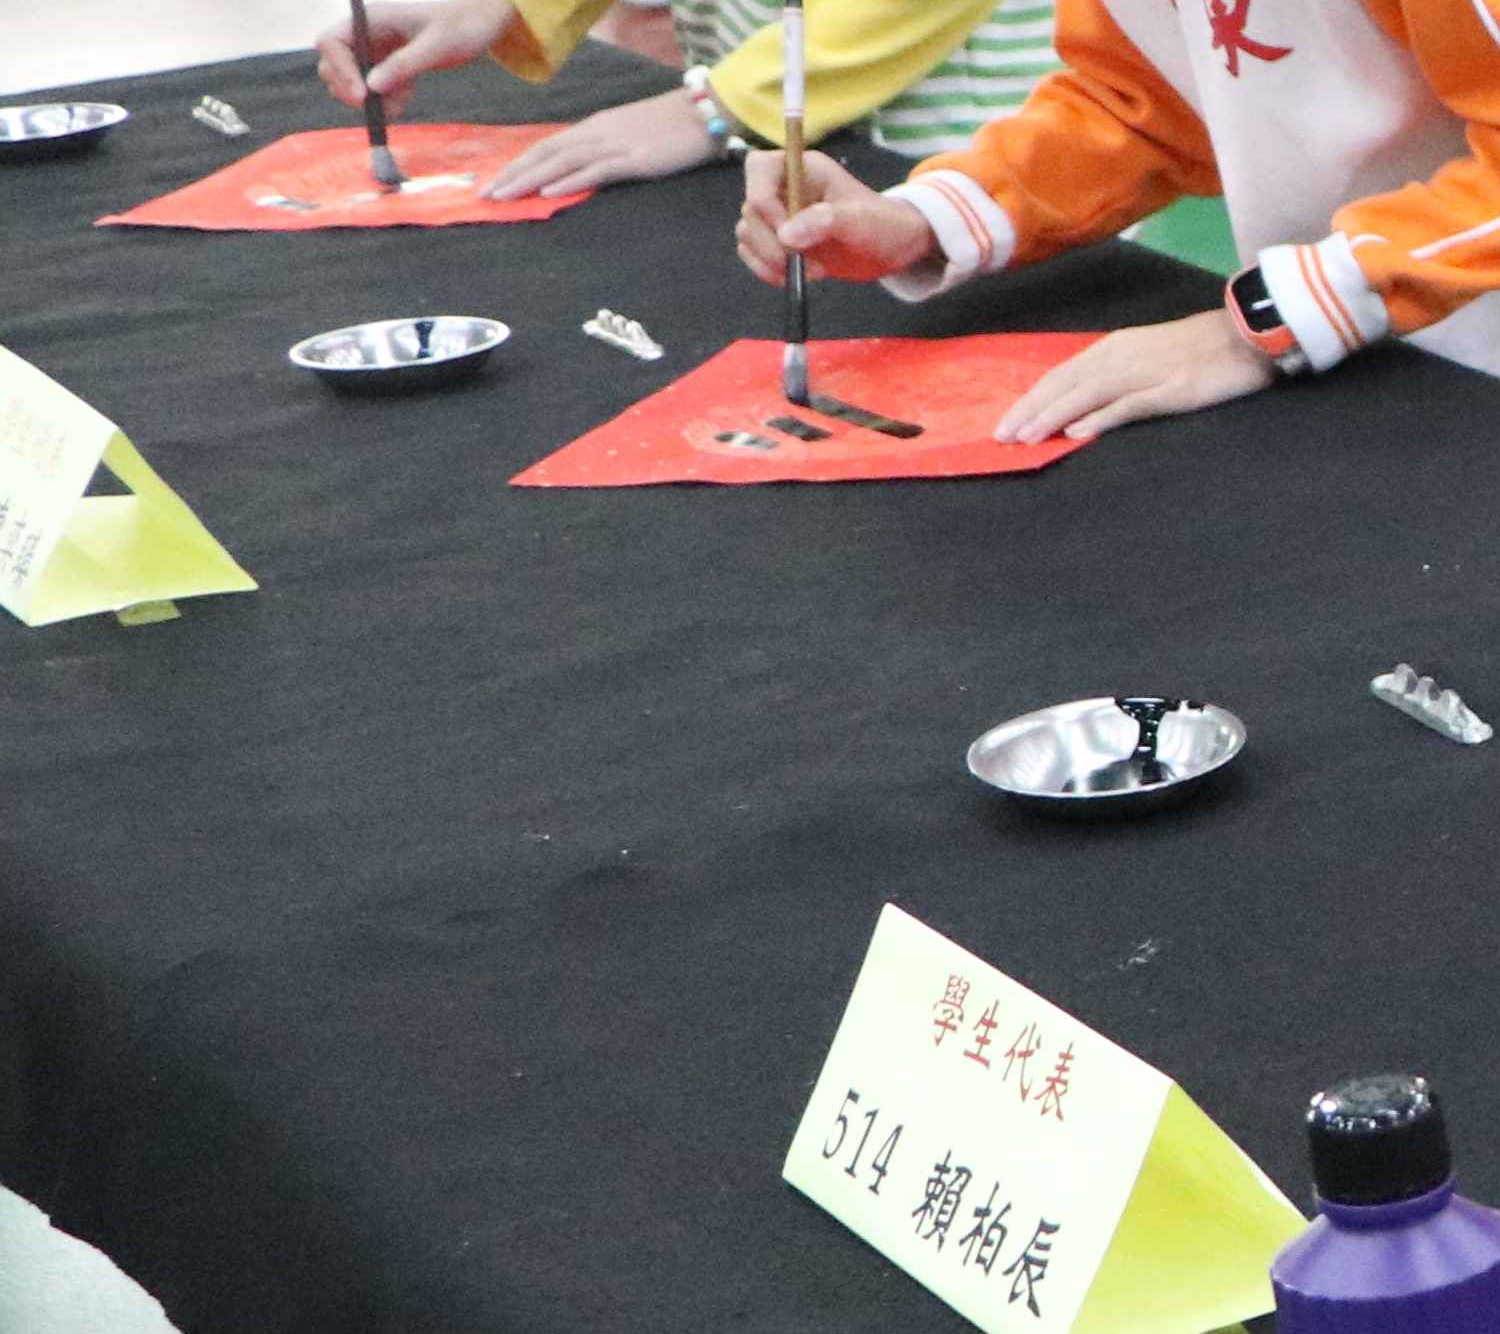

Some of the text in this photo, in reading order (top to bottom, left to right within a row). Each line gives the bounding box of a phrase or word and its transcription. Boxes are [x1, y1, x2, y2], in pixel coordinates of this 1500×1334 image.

[932, 973, 1075, 1122] 學生代表
[821, 1088, 1061, 1318] 514 賴柏辰
